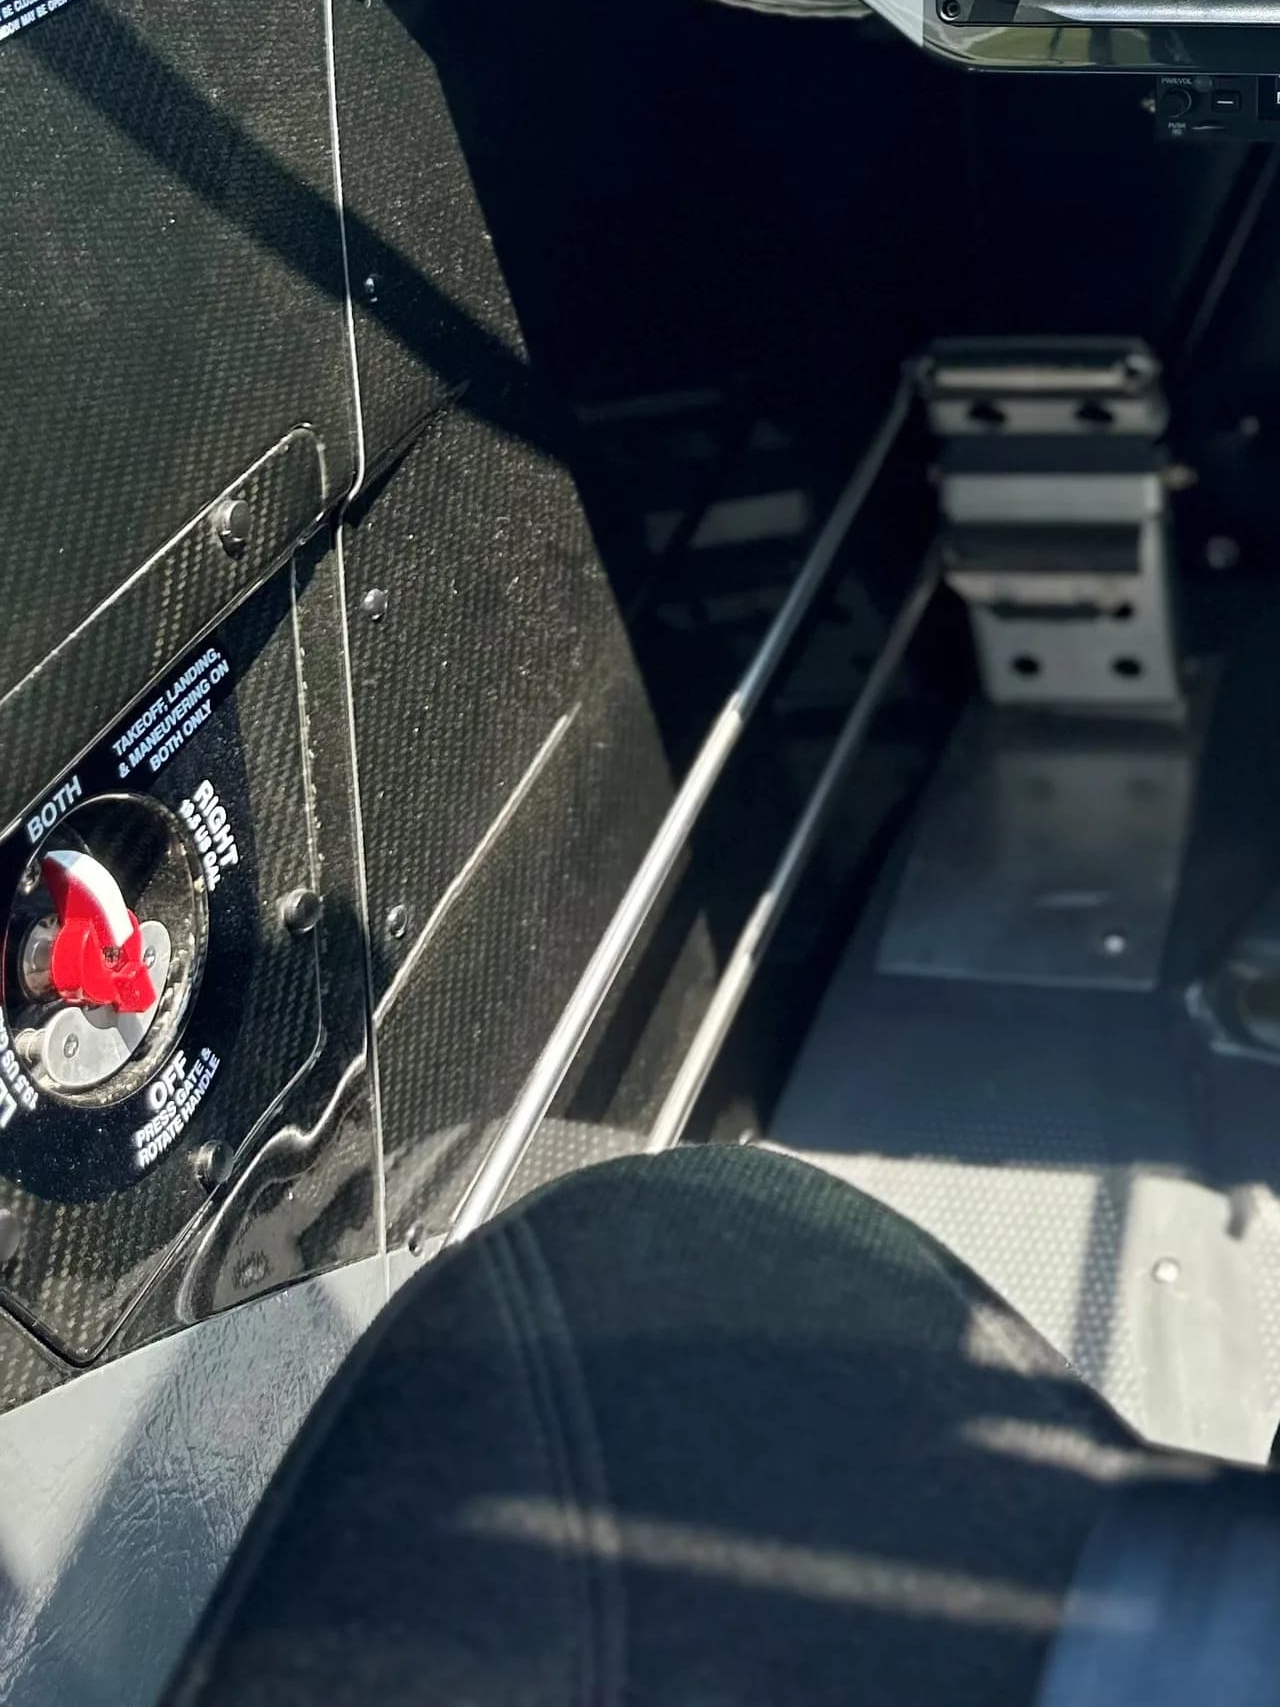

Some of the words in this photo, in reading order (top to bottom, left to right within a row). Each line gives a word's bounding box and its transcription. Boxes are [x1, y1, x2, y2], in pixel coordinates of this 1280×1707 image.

[2, 4, 14, 19] BE
[112, 695, 169, 757] TAKEOFF,
[165, 647, 221, 704] LANDING,
[118, 762, 130, 779] &
[127, 677, 211, 769] MANEUVERING
[209, 660, 230, 685] ON
[149, 733, 184, 773] BOTH
[182, 699, 213, 738] ONLY
[26, 774, 83, 843] BOTH
[193, 778, 239, 867] RIGHT
[134, 1100, 177, 1148] PRESS
[174, 1057, 205, 1107] GATE
[201, 1047, 215, 1061] &
[137, 1118, 186, 1169] ROTATE
[182, 1053, 221, 1124] HANDLE
[149, 1049, 188, 1112] OFF
